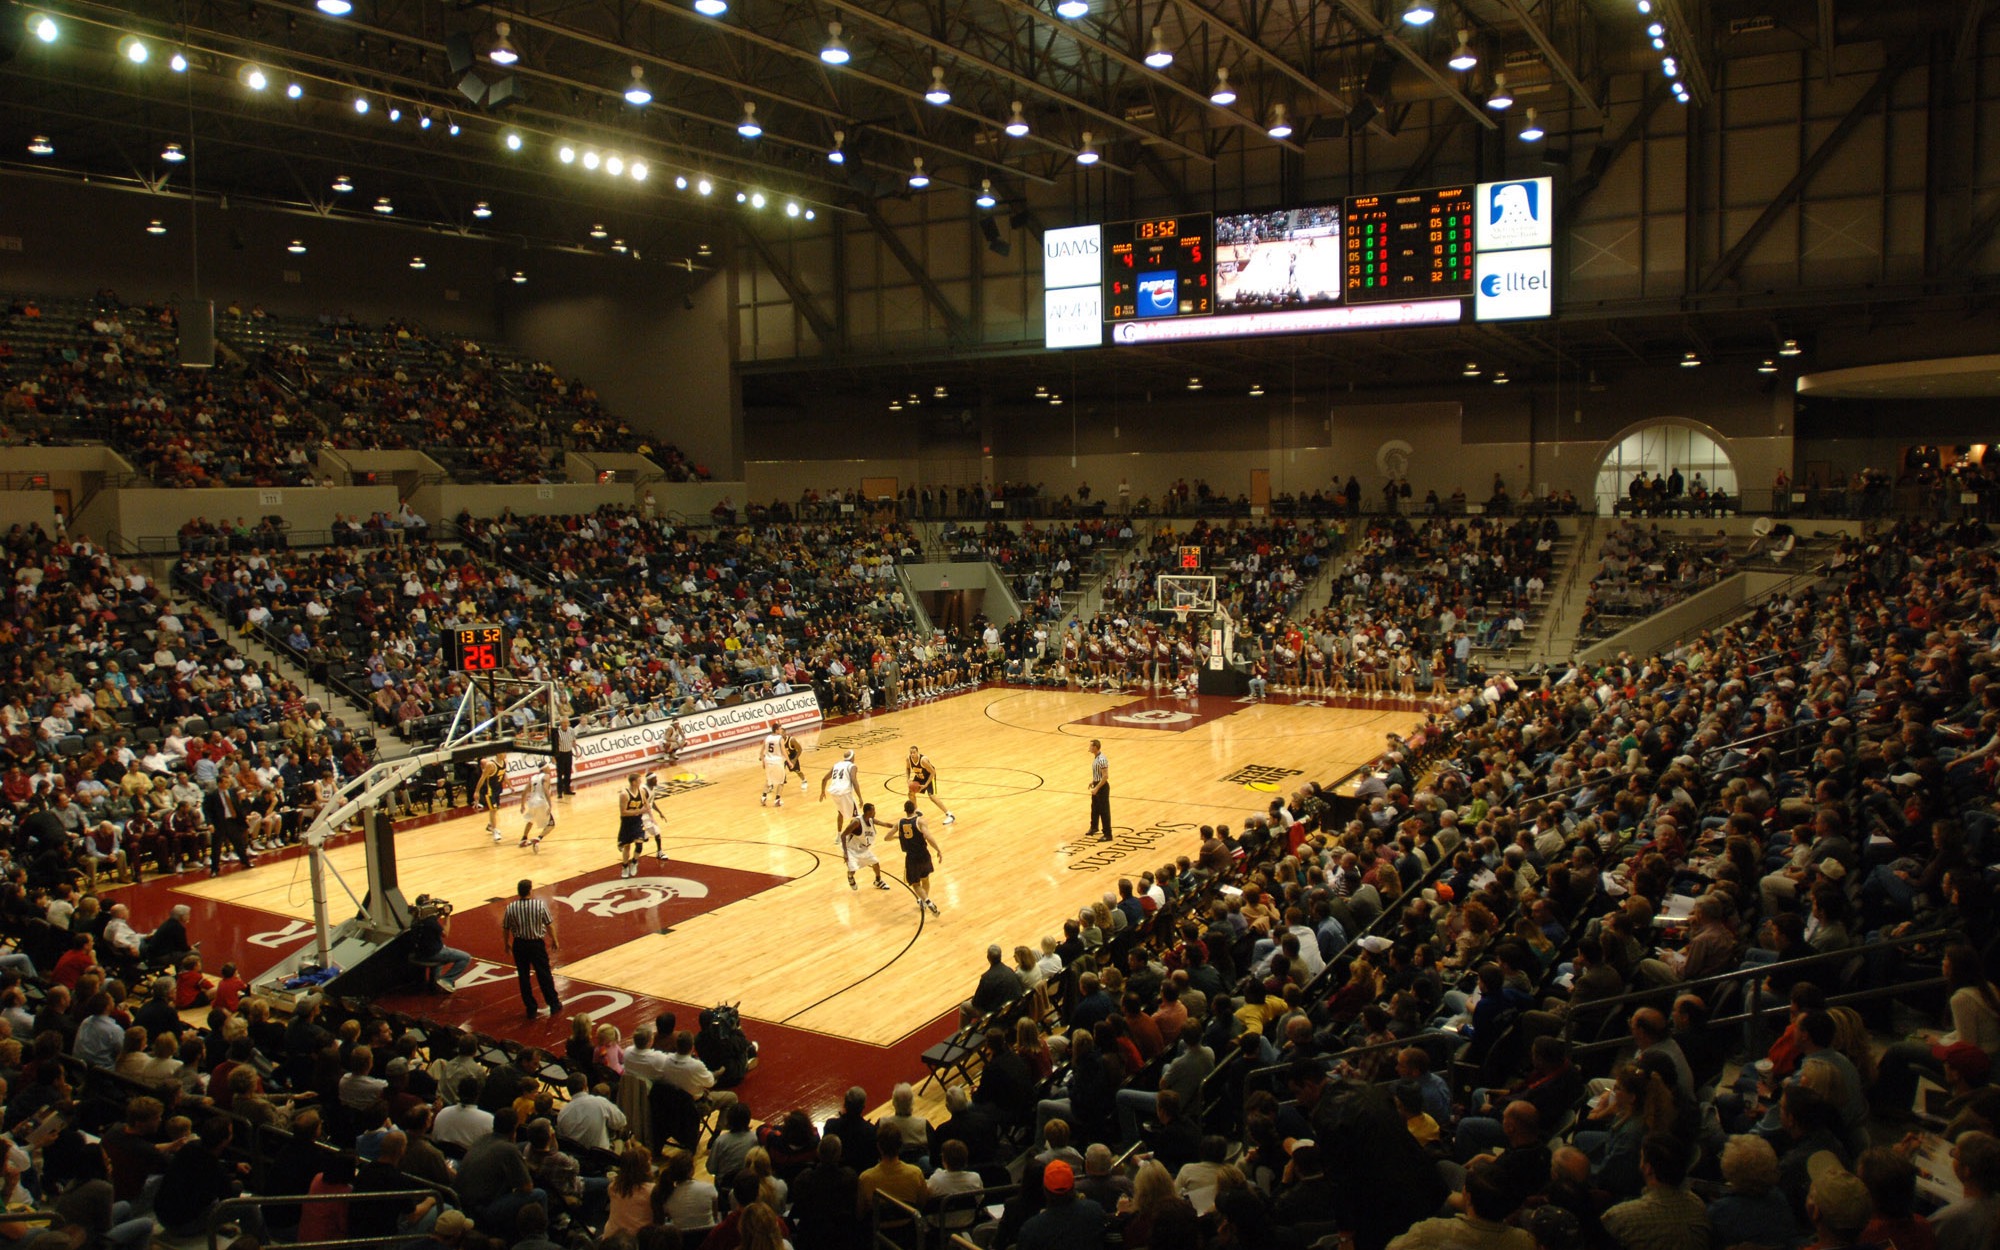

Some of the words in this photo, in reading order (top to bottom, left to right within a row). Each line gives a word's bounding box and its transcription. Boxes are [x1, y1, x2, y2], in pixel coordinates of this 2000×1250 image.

[1430, 218, 1442, 228] 05
[1449, 216, 1456, 226] 0
[1463, 215, 1471, 225] 0
[1142, 220, 1176, 238] 13:52
[1348, 226, 1360, 236] 01
[1366, 224, 1373, 234] 0
[1380, 222, 1387, 233] 2
[1430, 231, 1442, 242] 03
[1449, 230, 1456, 240] 0
[1463, 228, 1471, 239] 3
[1048, 238, 1099, 258] UAMS
[1348, 239, 1360, 249] 03
[1366, 238, 1373, 247] 0
[1380, 236, 1387, 247] 2
[1434, 244, 1443, 255] 10
[1449, 244, 1456, 254] 0
[1463, 242, 1471, 253] 0
[1123, 253, 1133, 268] 4
[1192, 246, 1202, 263] 5
[1348, 252, 1360, 262] 05
[1366, 250, 1373, 260] 0
[1380, 249, 1387, 260] 0
[1434, 258, 1443, 268] 15
[1449, 257, 1456, 268] 0
[1463, 255, 1471, 266] 0
[1348, 265, 1360, 275] 23
[1366, 264, 1373, 274] 0
[1380, 262, 1387, 273] 0
[1348, 278, 1360, 289] 24
[1366, 277, 1373, 287] 0
[1380, 275, 1387, 286] 0
[1430, 272, 1442, 282] 32
[1452, 271, 1457, 280] 1
[1463, 269, 1471, 280] 2
[1113, 282, 1120, 294] 5
[1200, 274, 1207, 287] 5
[1114, 305, 1120, 317] 0
[1200, 299, 1207, 310] 2
[1182, 555, 1198, 567] 26
[464, 644, 496, 671] 26
[737, 726, 750, 734] Health
[768, 743, 774, 753] 5
[590, 760, 606, 768] Better
[607, 756, 624, 765] Health
[625, 754, 636, 762] Plan
[832, 768, 845, 780] 24
[1068, 820, 1197, 872] Stephens
